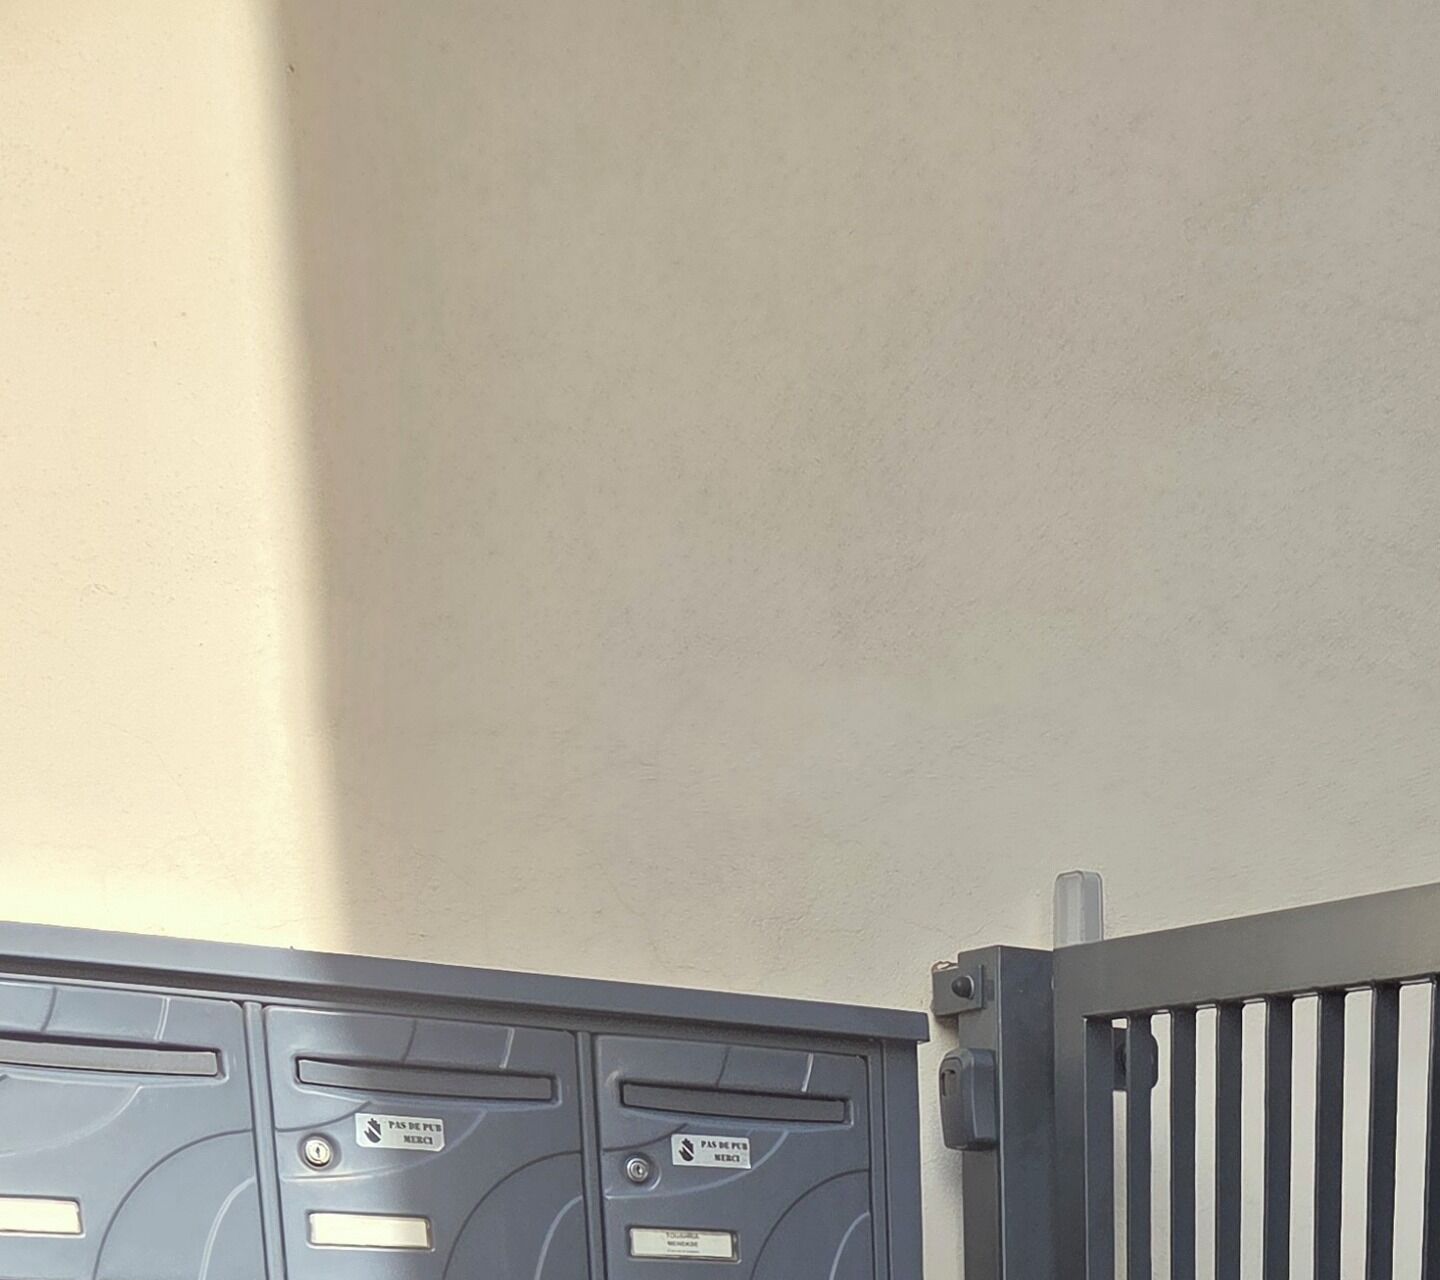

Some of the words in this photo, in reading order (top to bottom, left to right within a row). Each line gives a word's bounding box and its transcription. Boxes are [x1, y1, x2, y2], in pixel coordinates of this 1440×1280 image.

[388, 1120, 407, 1129] PAS
[408, 1121, 421, 1131] DE
[422, 1122, 442, 1132] PUB
[403, 1135, 434, 1145] MERCI
[700, 1140, 717, 1149] PAS
[718, 1141, 730, 1150] DE
[714, 1153, 740, 1162] MERCI
